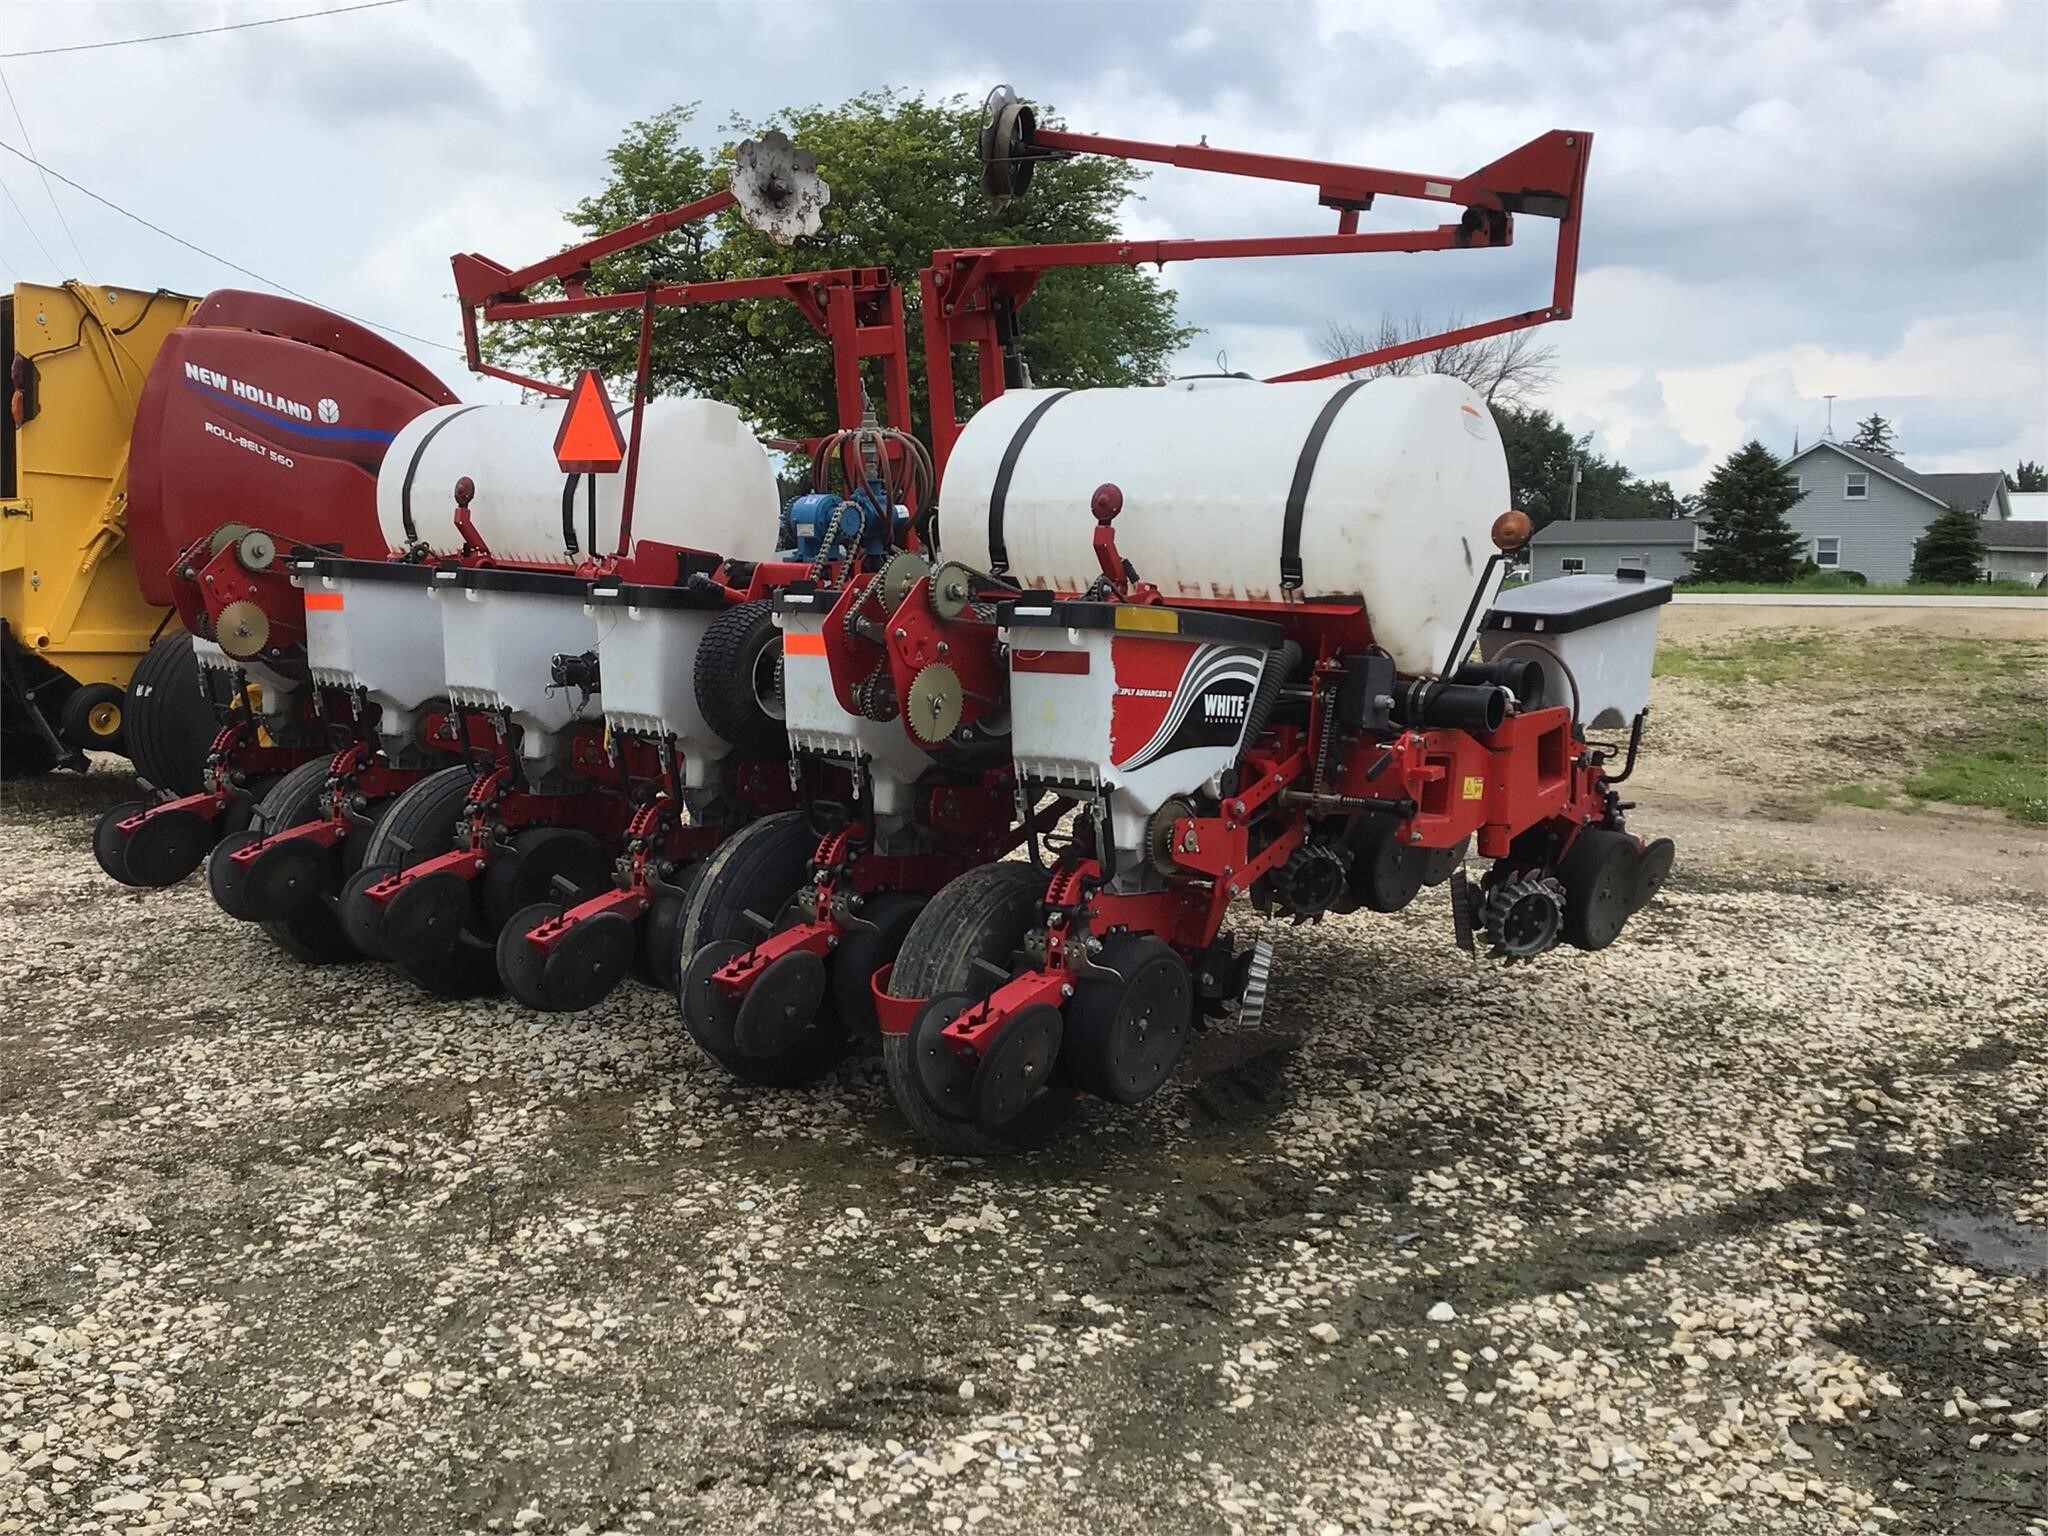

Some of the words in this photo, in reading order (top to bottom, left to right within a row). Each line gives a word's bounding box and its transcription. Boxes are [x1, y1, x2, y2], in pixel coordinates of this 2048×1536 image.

[184, 361, 228, 391] NEW
[231, 379, 313, 422] HOLLAND
[204, 421, 267, 456] ROLL-BELT
[269, 450, 295, 469] 560
[1204, 693, 1245, 718] WHITE
